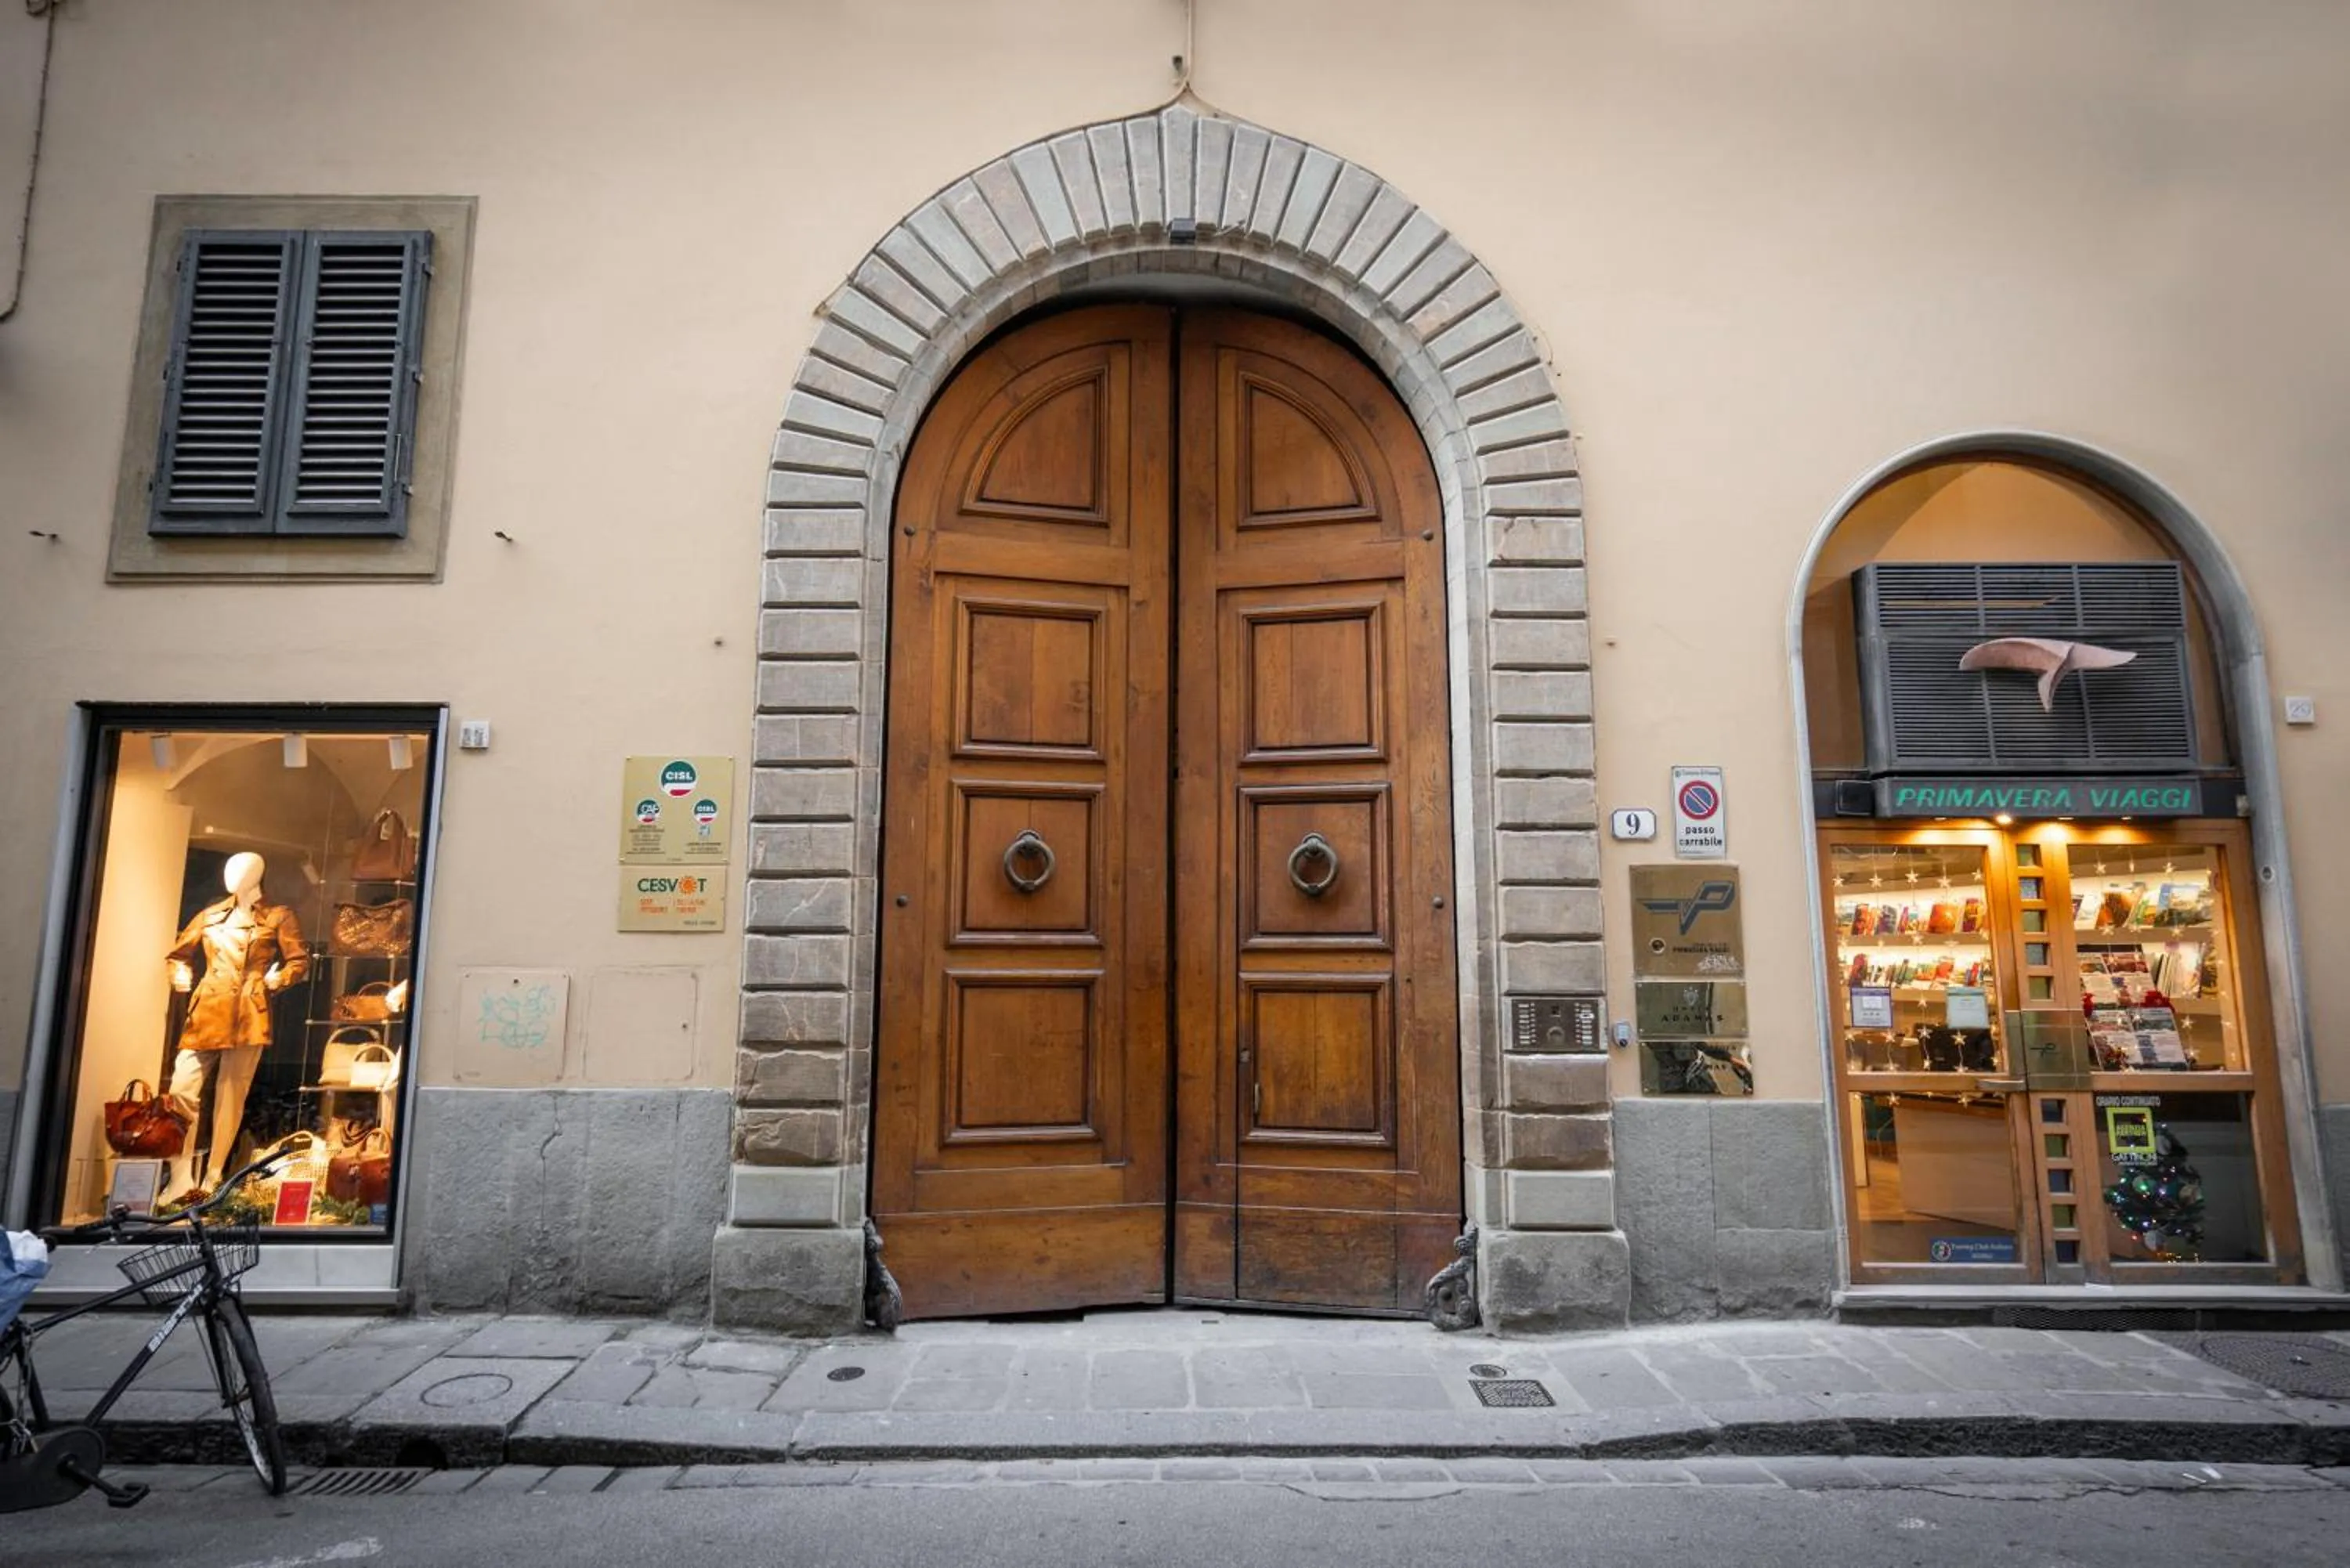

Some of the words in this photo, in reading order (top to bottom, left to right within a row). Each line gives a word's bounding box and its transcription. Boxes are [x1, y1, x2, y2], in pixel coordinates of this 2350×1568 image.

[665, 771, 693, 781] CISL
[1896, 788, 2073, 807] PRIMAVERA
[2090, 788, 2192, 808] VIAGGI
[1626, 812, 1641, 836] 9
[1685, 826, 1716, 835] passo
[1679, 837, 1723, 847] carrabile
